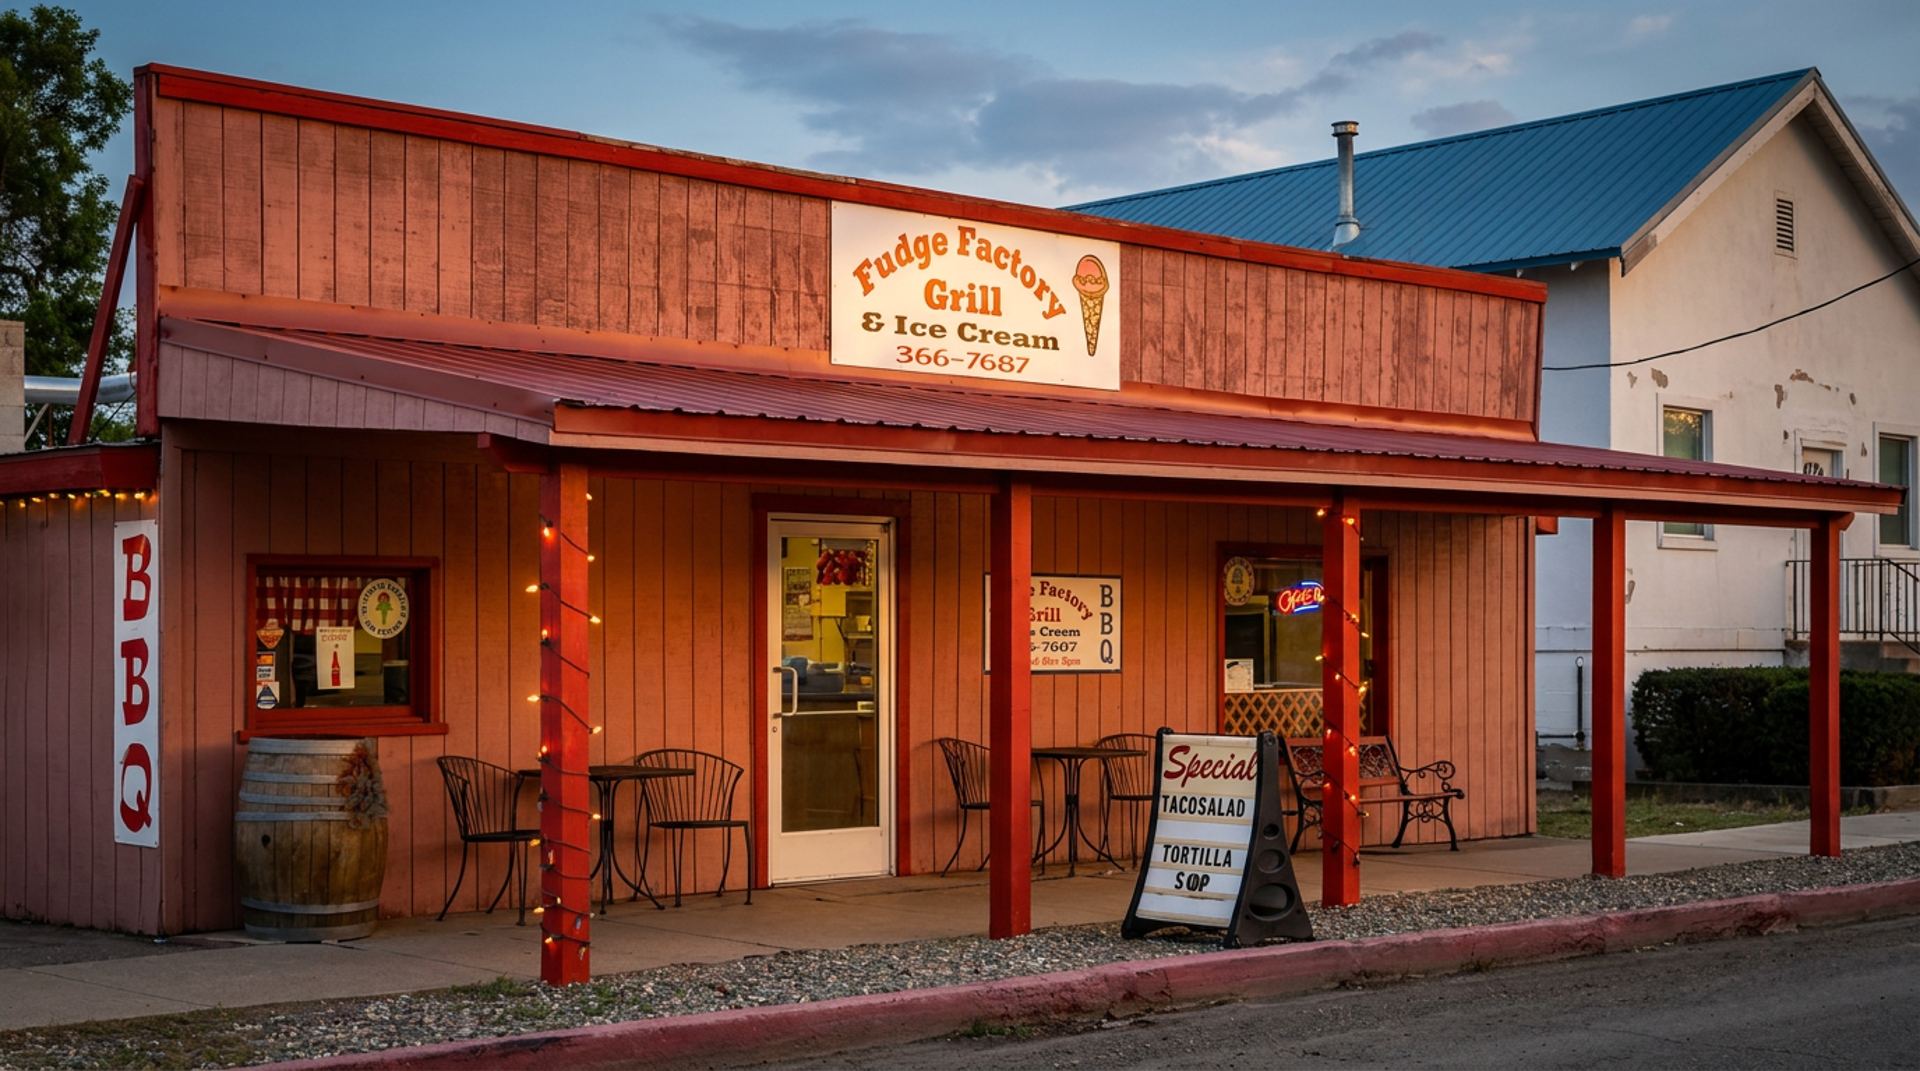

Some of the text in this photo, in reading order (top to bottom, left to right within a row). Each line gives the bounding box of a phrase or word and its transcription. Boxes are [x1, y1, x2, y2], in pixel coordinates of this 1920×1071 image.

[852, 225, 1067, 320] Fudge Factory
[923, 278, 1002, 317] Grill
[861, 311, 1060, 350] & Ice Cream
[896, 346, 1030, 373] 366-7687
[1099, 584, 1113, 664] BBQ
[120, 533, 152, 833] BBQ
[1163, 745, 1258, 788] Special
[1163, 844, 1232, 868] TORTILLA
